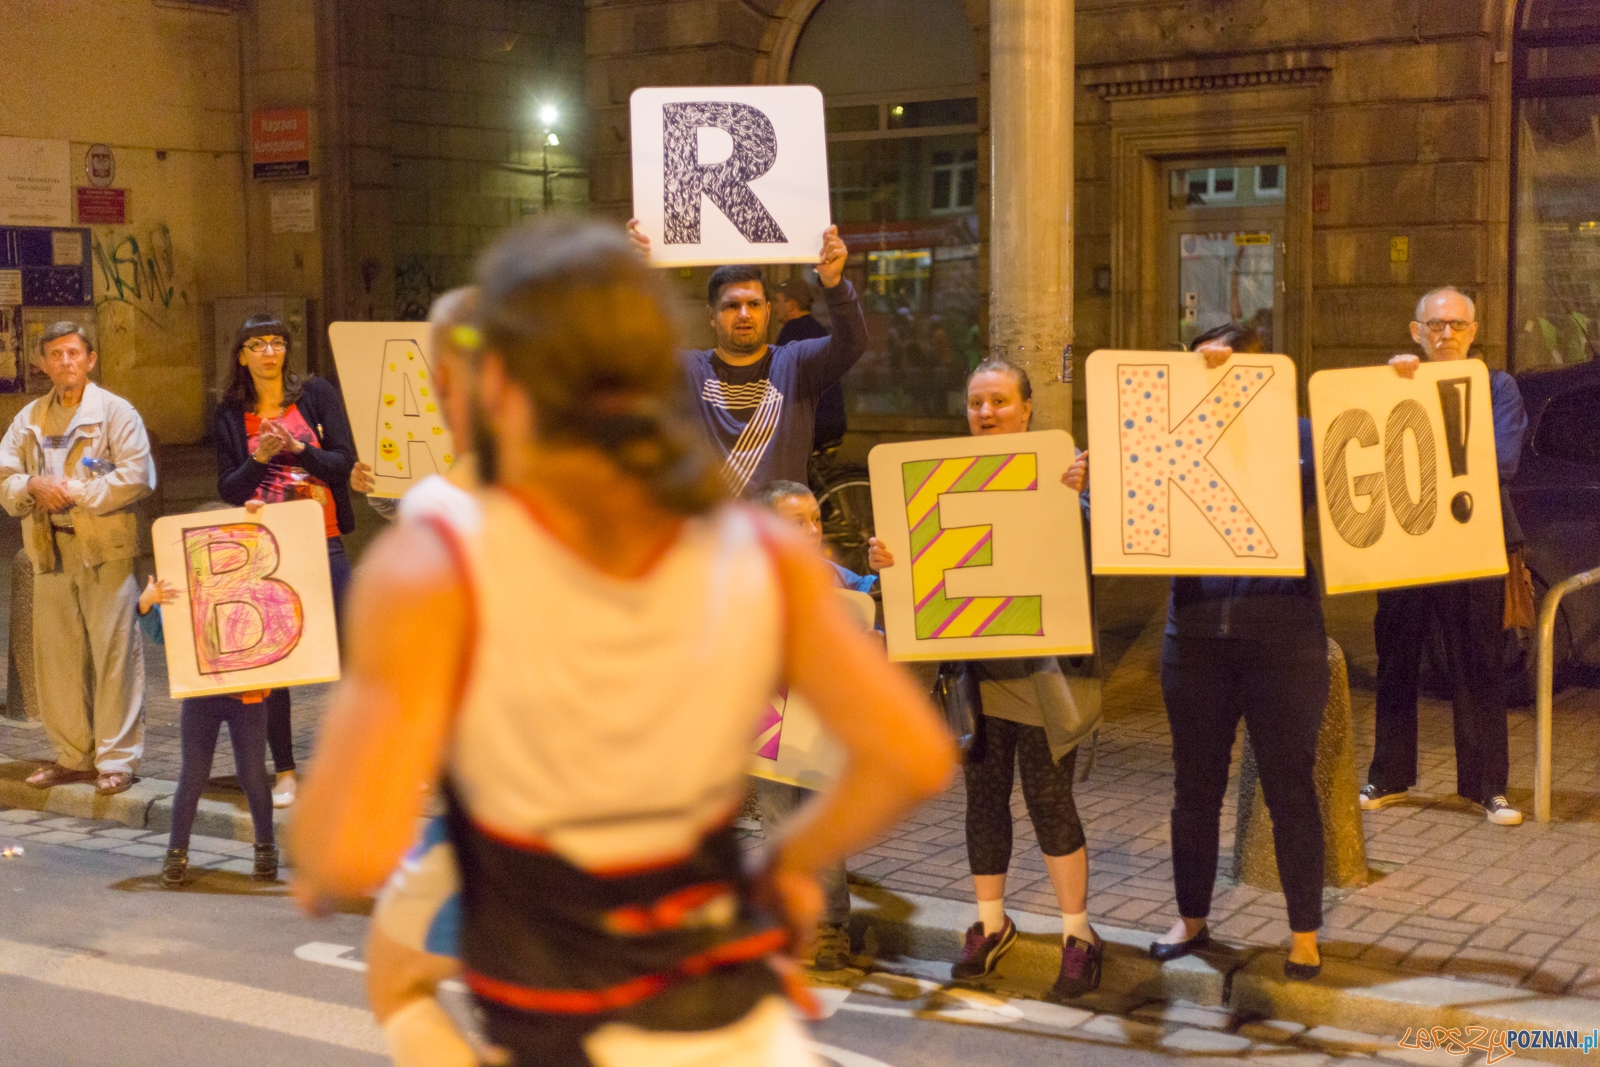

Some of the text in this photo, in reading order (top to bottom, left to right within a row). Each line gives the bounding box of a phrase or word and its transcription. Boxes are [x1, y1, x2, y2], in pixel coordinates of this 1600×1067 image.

[661, 101, 789, 244] R
[374, 338, 451, 480] A
[1117, 364, 1279, 558] K
[1323, 376, 1474, 549] GO!
[181, 521, 304, 676] B
[901, 452, 1045, 640] E
